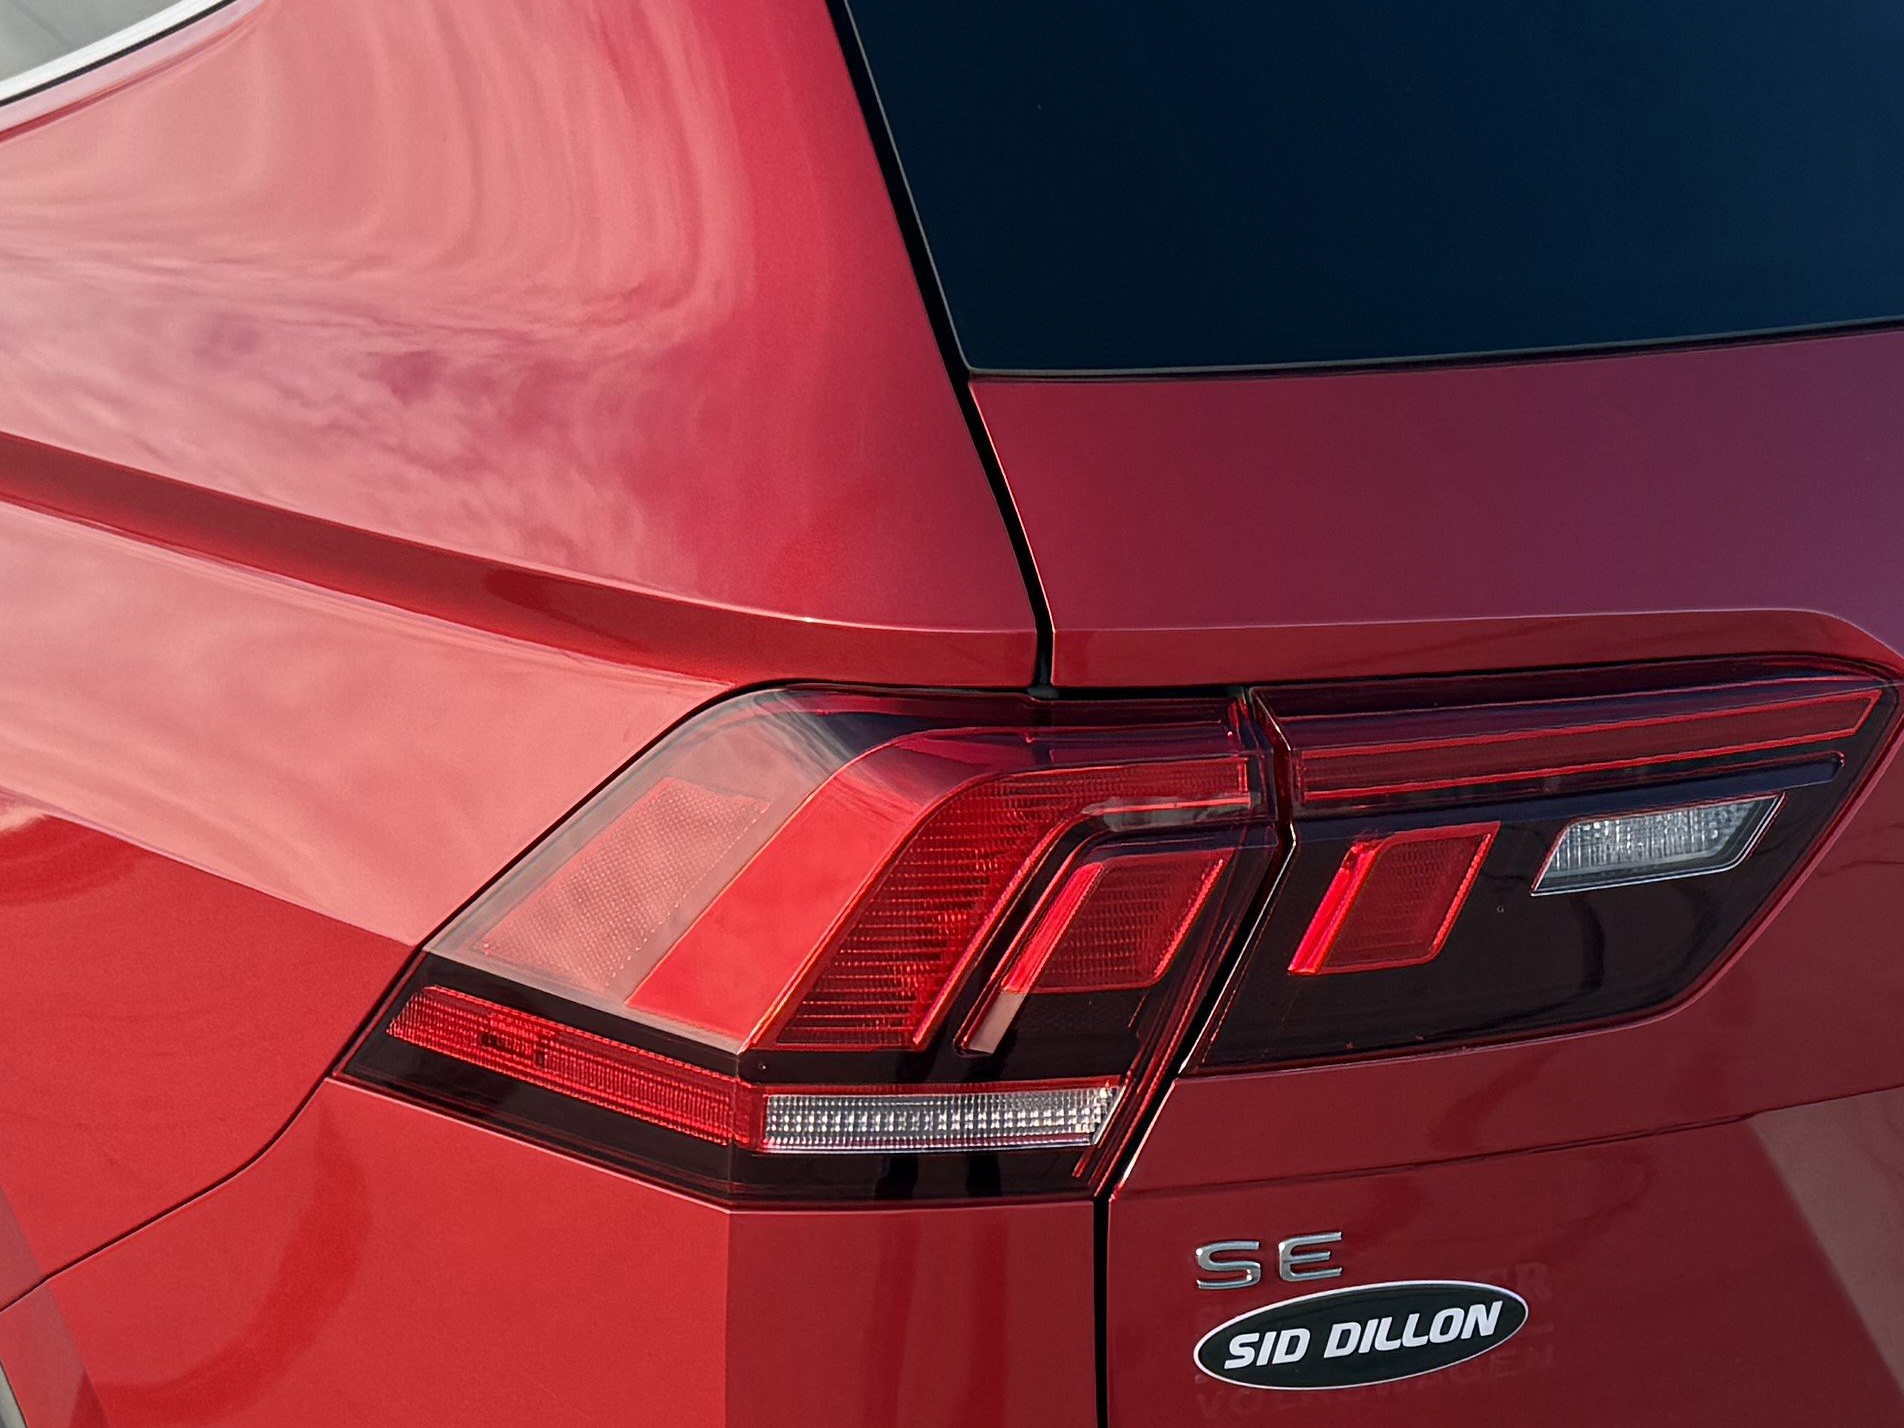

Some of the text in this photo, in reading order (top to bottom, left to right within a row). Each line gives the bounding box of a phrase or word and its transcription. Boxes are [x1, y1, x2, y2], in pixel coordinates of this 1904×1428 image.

[1196, 1232, 1342, 1289] SE
[1224, 1301, 1503, 1370] SID DILLON
